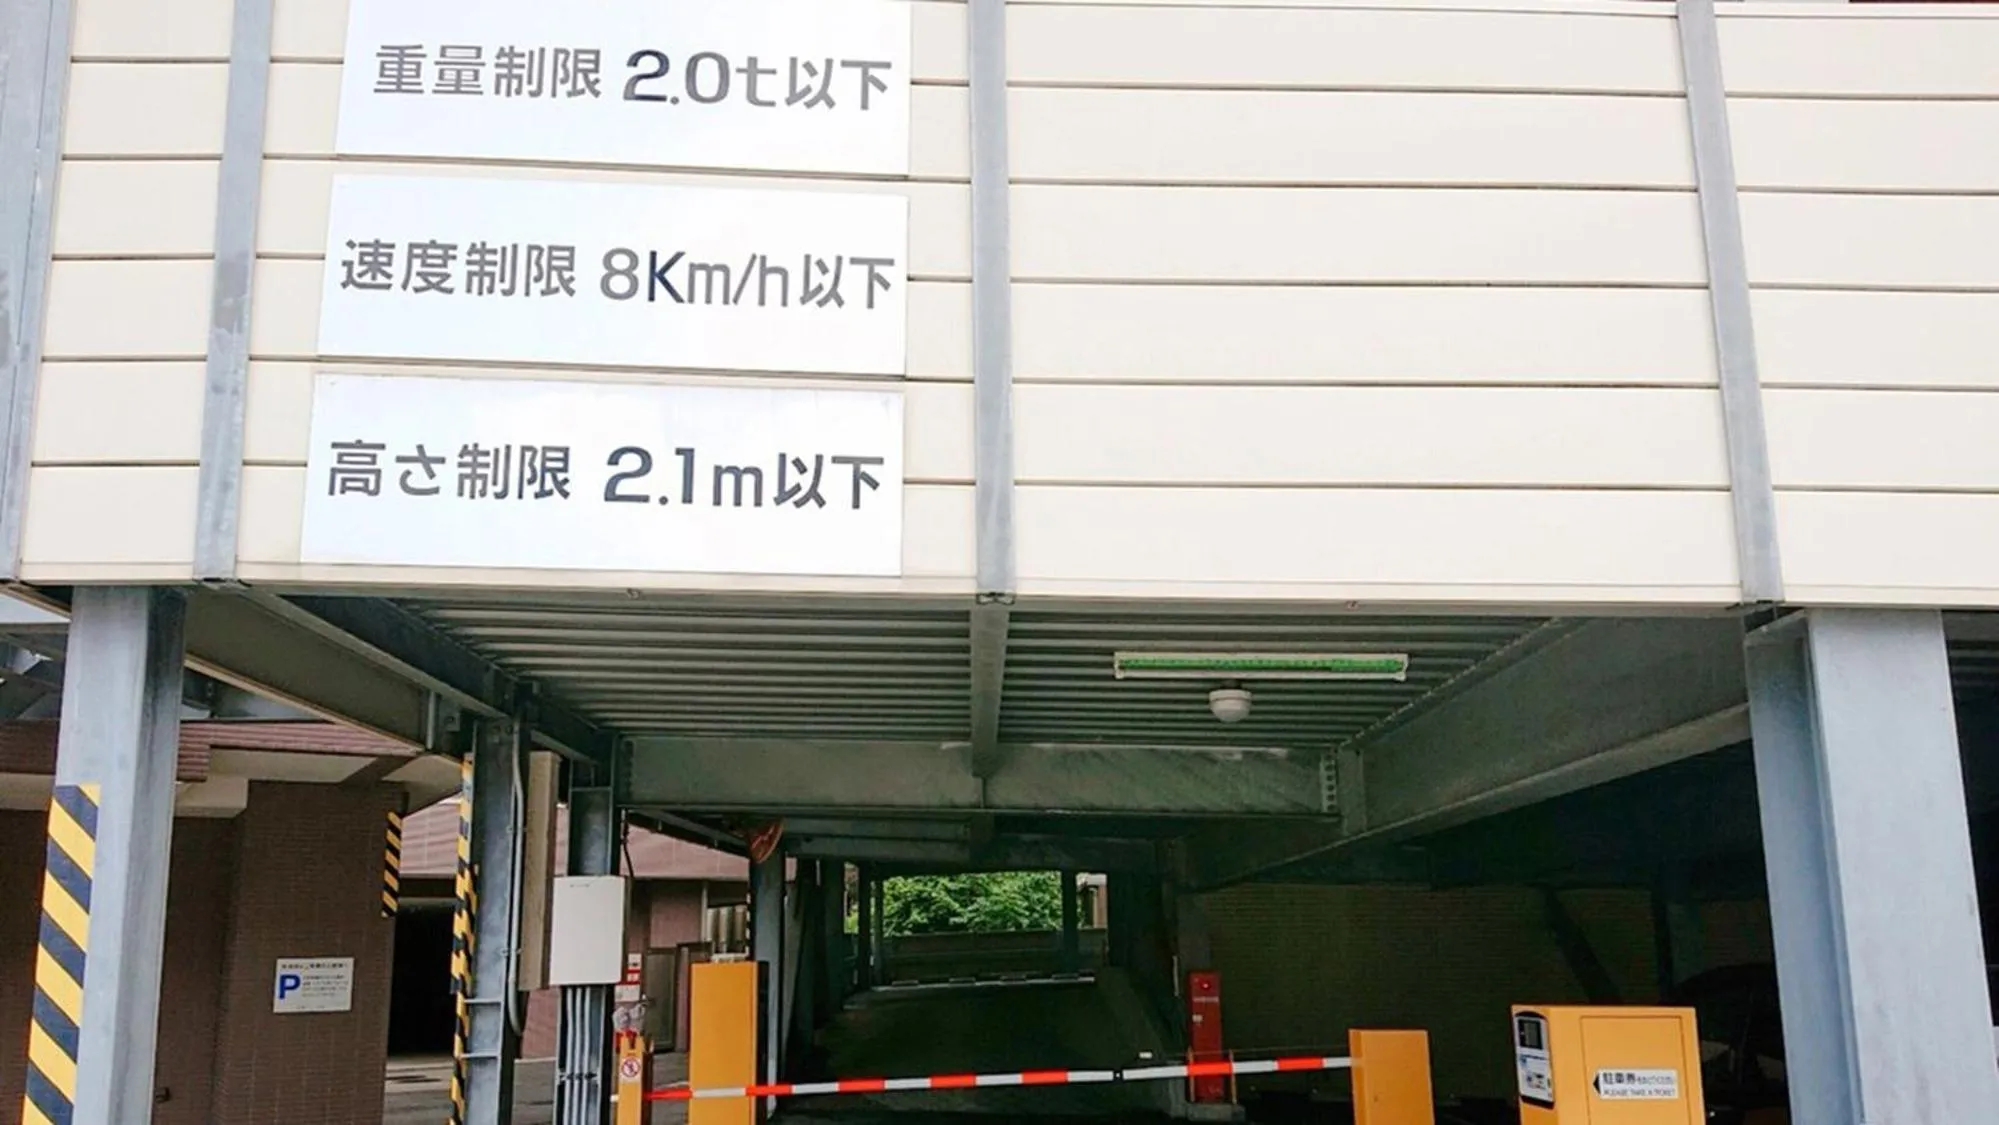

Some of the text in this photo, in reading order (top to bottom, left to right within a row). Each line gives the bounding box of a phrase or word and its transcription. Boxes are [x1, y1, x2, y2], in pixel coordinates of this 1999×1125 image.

[374, 45, 892, 111] 重量制限 2.0t以下
[341, 239, 895, 310] 速度制限 8Km/h以下
[328, 439, 885, 510] 高さ制限 2.1m以下
[279, 974, 300, 999] P
